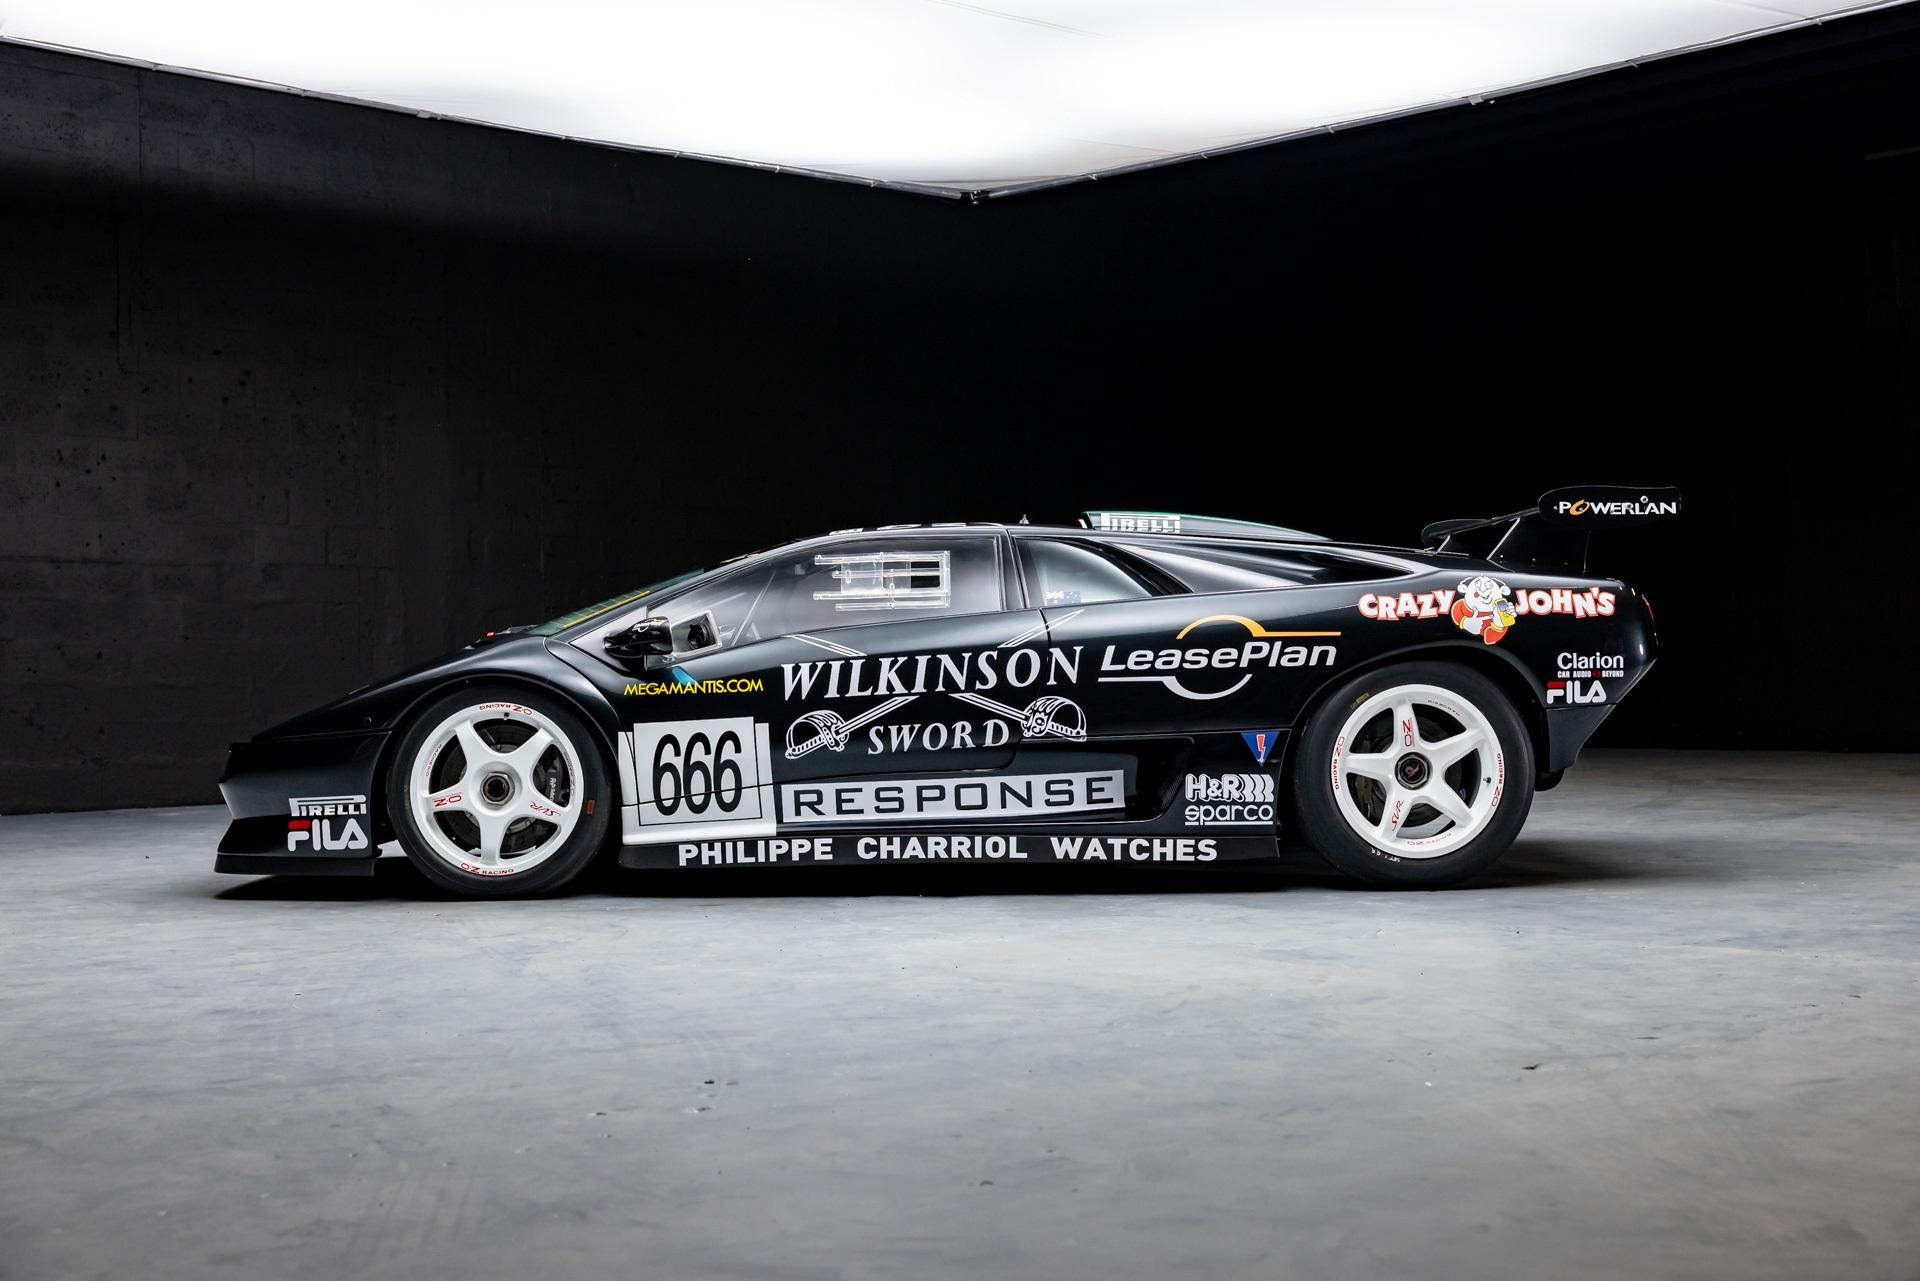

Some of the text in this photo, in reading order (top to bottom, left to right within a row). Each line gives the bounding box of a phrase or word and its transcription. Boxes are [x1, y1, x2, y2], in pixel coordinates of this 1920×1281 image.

[1559, 499, 1677, 515] POWERLAN
[1101, 512, 1181, 533] PIRELLI
[1358, 586, 1616, 621] CRAZY JOHN'S
[1101, 641, 1337, 671] LeasePlan
[1557, 652, 1624, 670] Clarion
[780, 646, 1085, 701] WILKINSON
[1557, 670, 1624, 678] CAR AUDIO BEYOND
[623, 679, 764, 695] MEGAMANTIS.COM
[1547, 680, 1607, 704] FILA
[480, 703, 511, 711] RACING
[868, 719, 1009, 755] SWORD
[652, 730, 742, 816] 666
[793, 775, 1114, 817] RESPONSE
[1185, 773, 1245, 802] H&R
[288, 794, 367, 816] PIRELLI
[1185, 804, 1273, 826] sparco
[287, 817, 369, 851] FILA
[678, 836, 1218, 866] PHILIPPE CHARRIOL WATCHES
[482, 868, 514, 876] RACING
